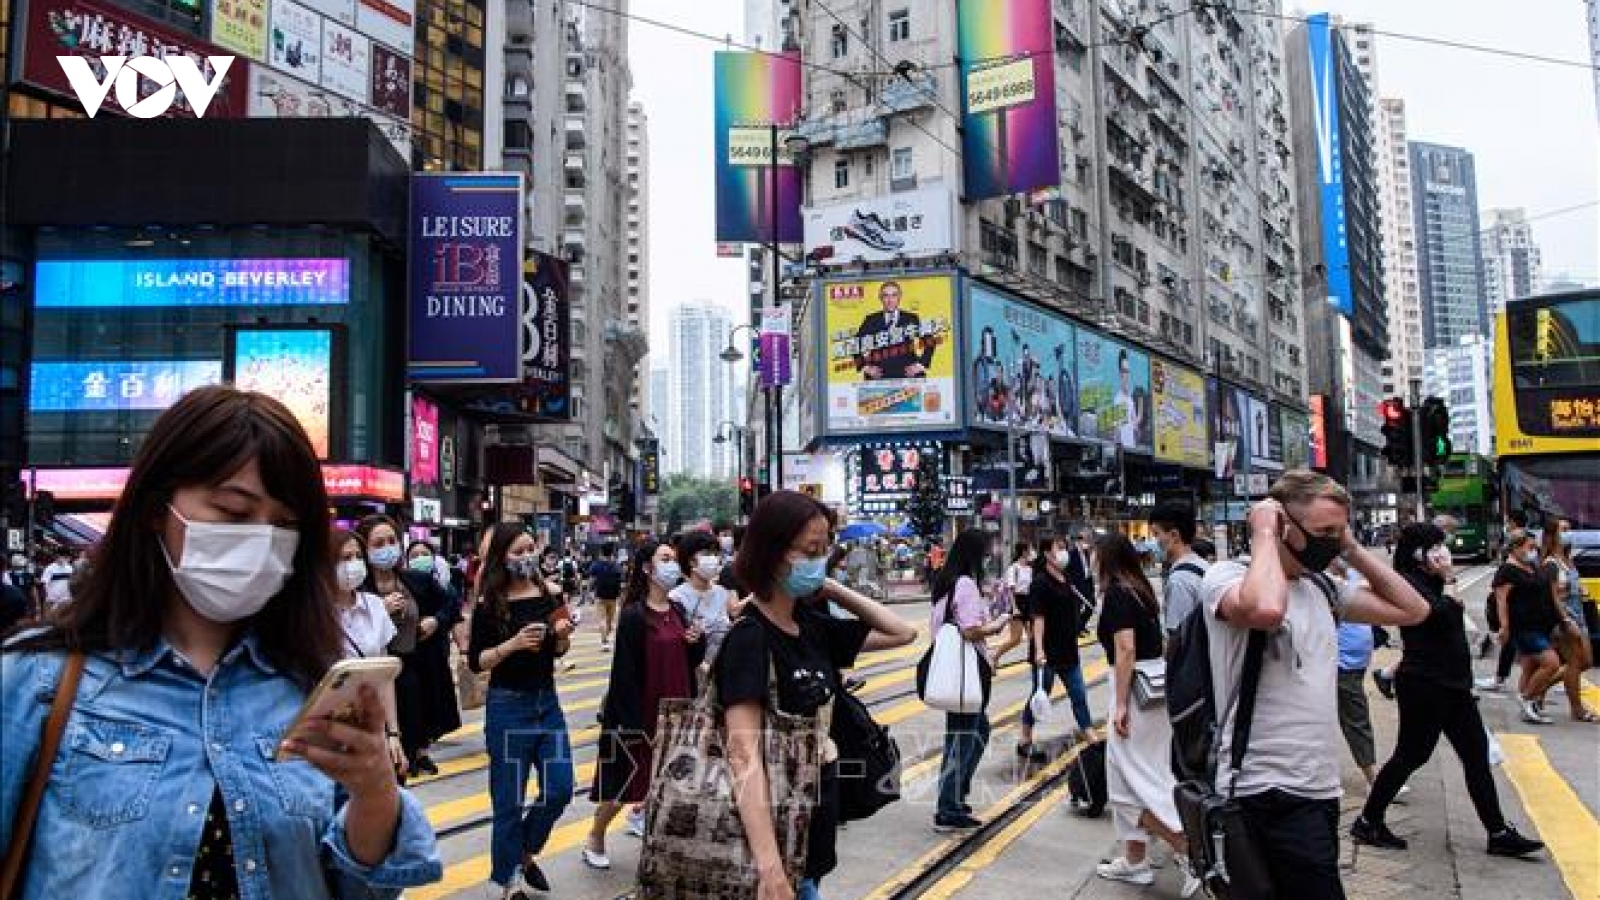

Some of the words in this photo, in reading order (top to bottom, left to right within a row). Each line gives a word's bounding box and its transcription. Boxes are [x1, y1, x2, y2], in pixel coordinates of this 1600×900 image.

[422, 216, 514, 238] LEISURE
[135, 271, 215, 287] ISLAND
[224, 271, 326, 287] BEVERLEY
[427, 295, 505, 317] DINING
